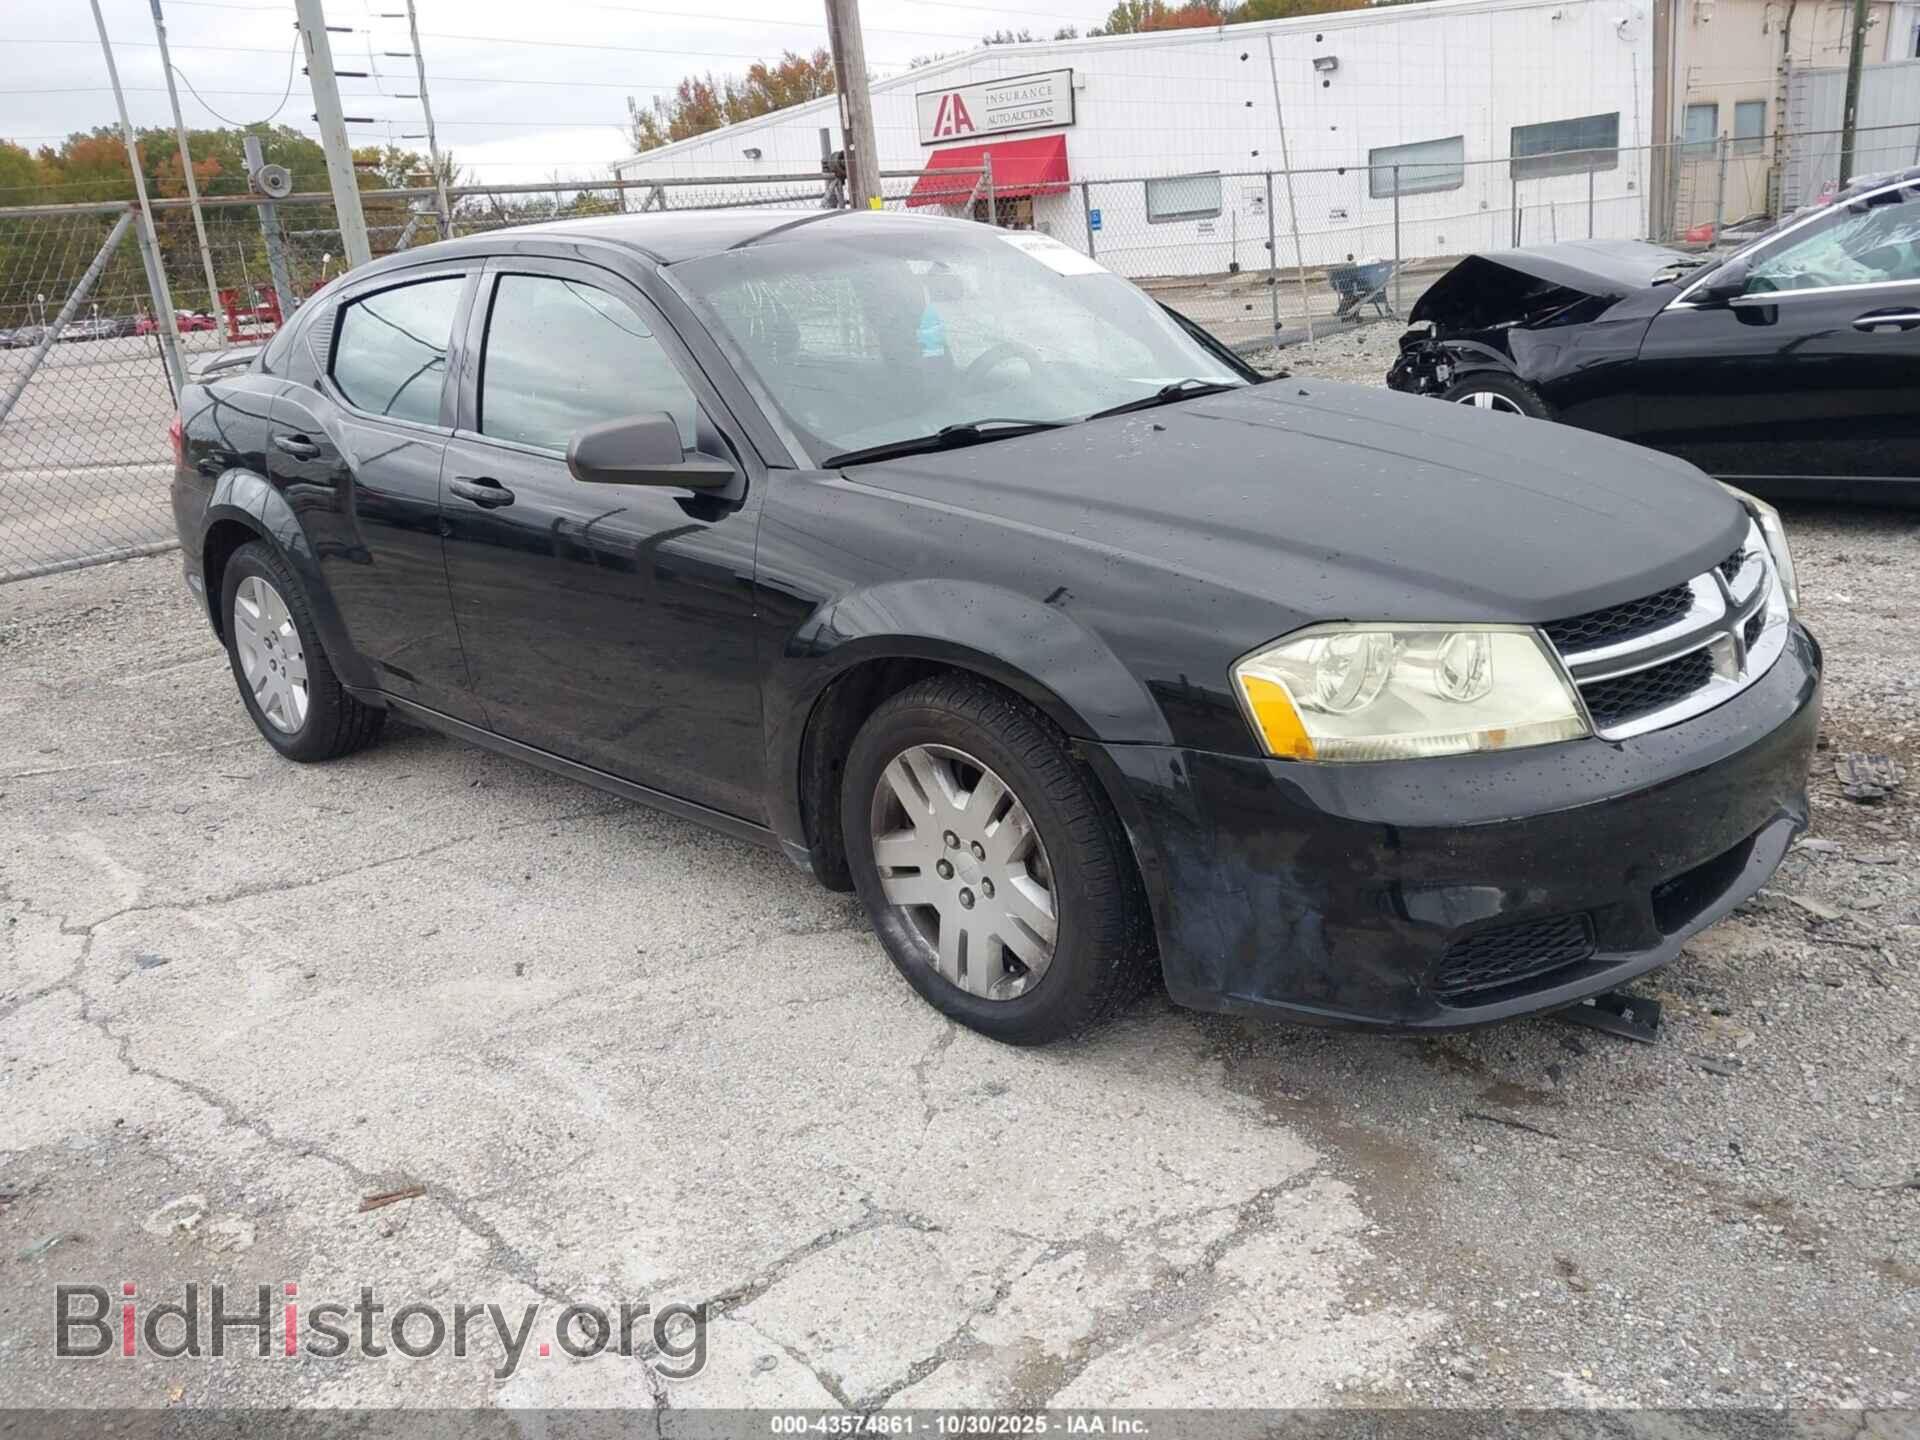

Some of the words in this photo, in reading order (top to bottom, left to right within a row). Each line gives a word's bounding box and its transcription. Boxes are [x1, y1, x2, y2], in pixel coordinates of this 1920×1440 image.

[985, 85, 1053, 105] INSURANCE
[987, 111, 1010, 126] AUTO
[1010, 106, 1054, 121] AUCTIONS
